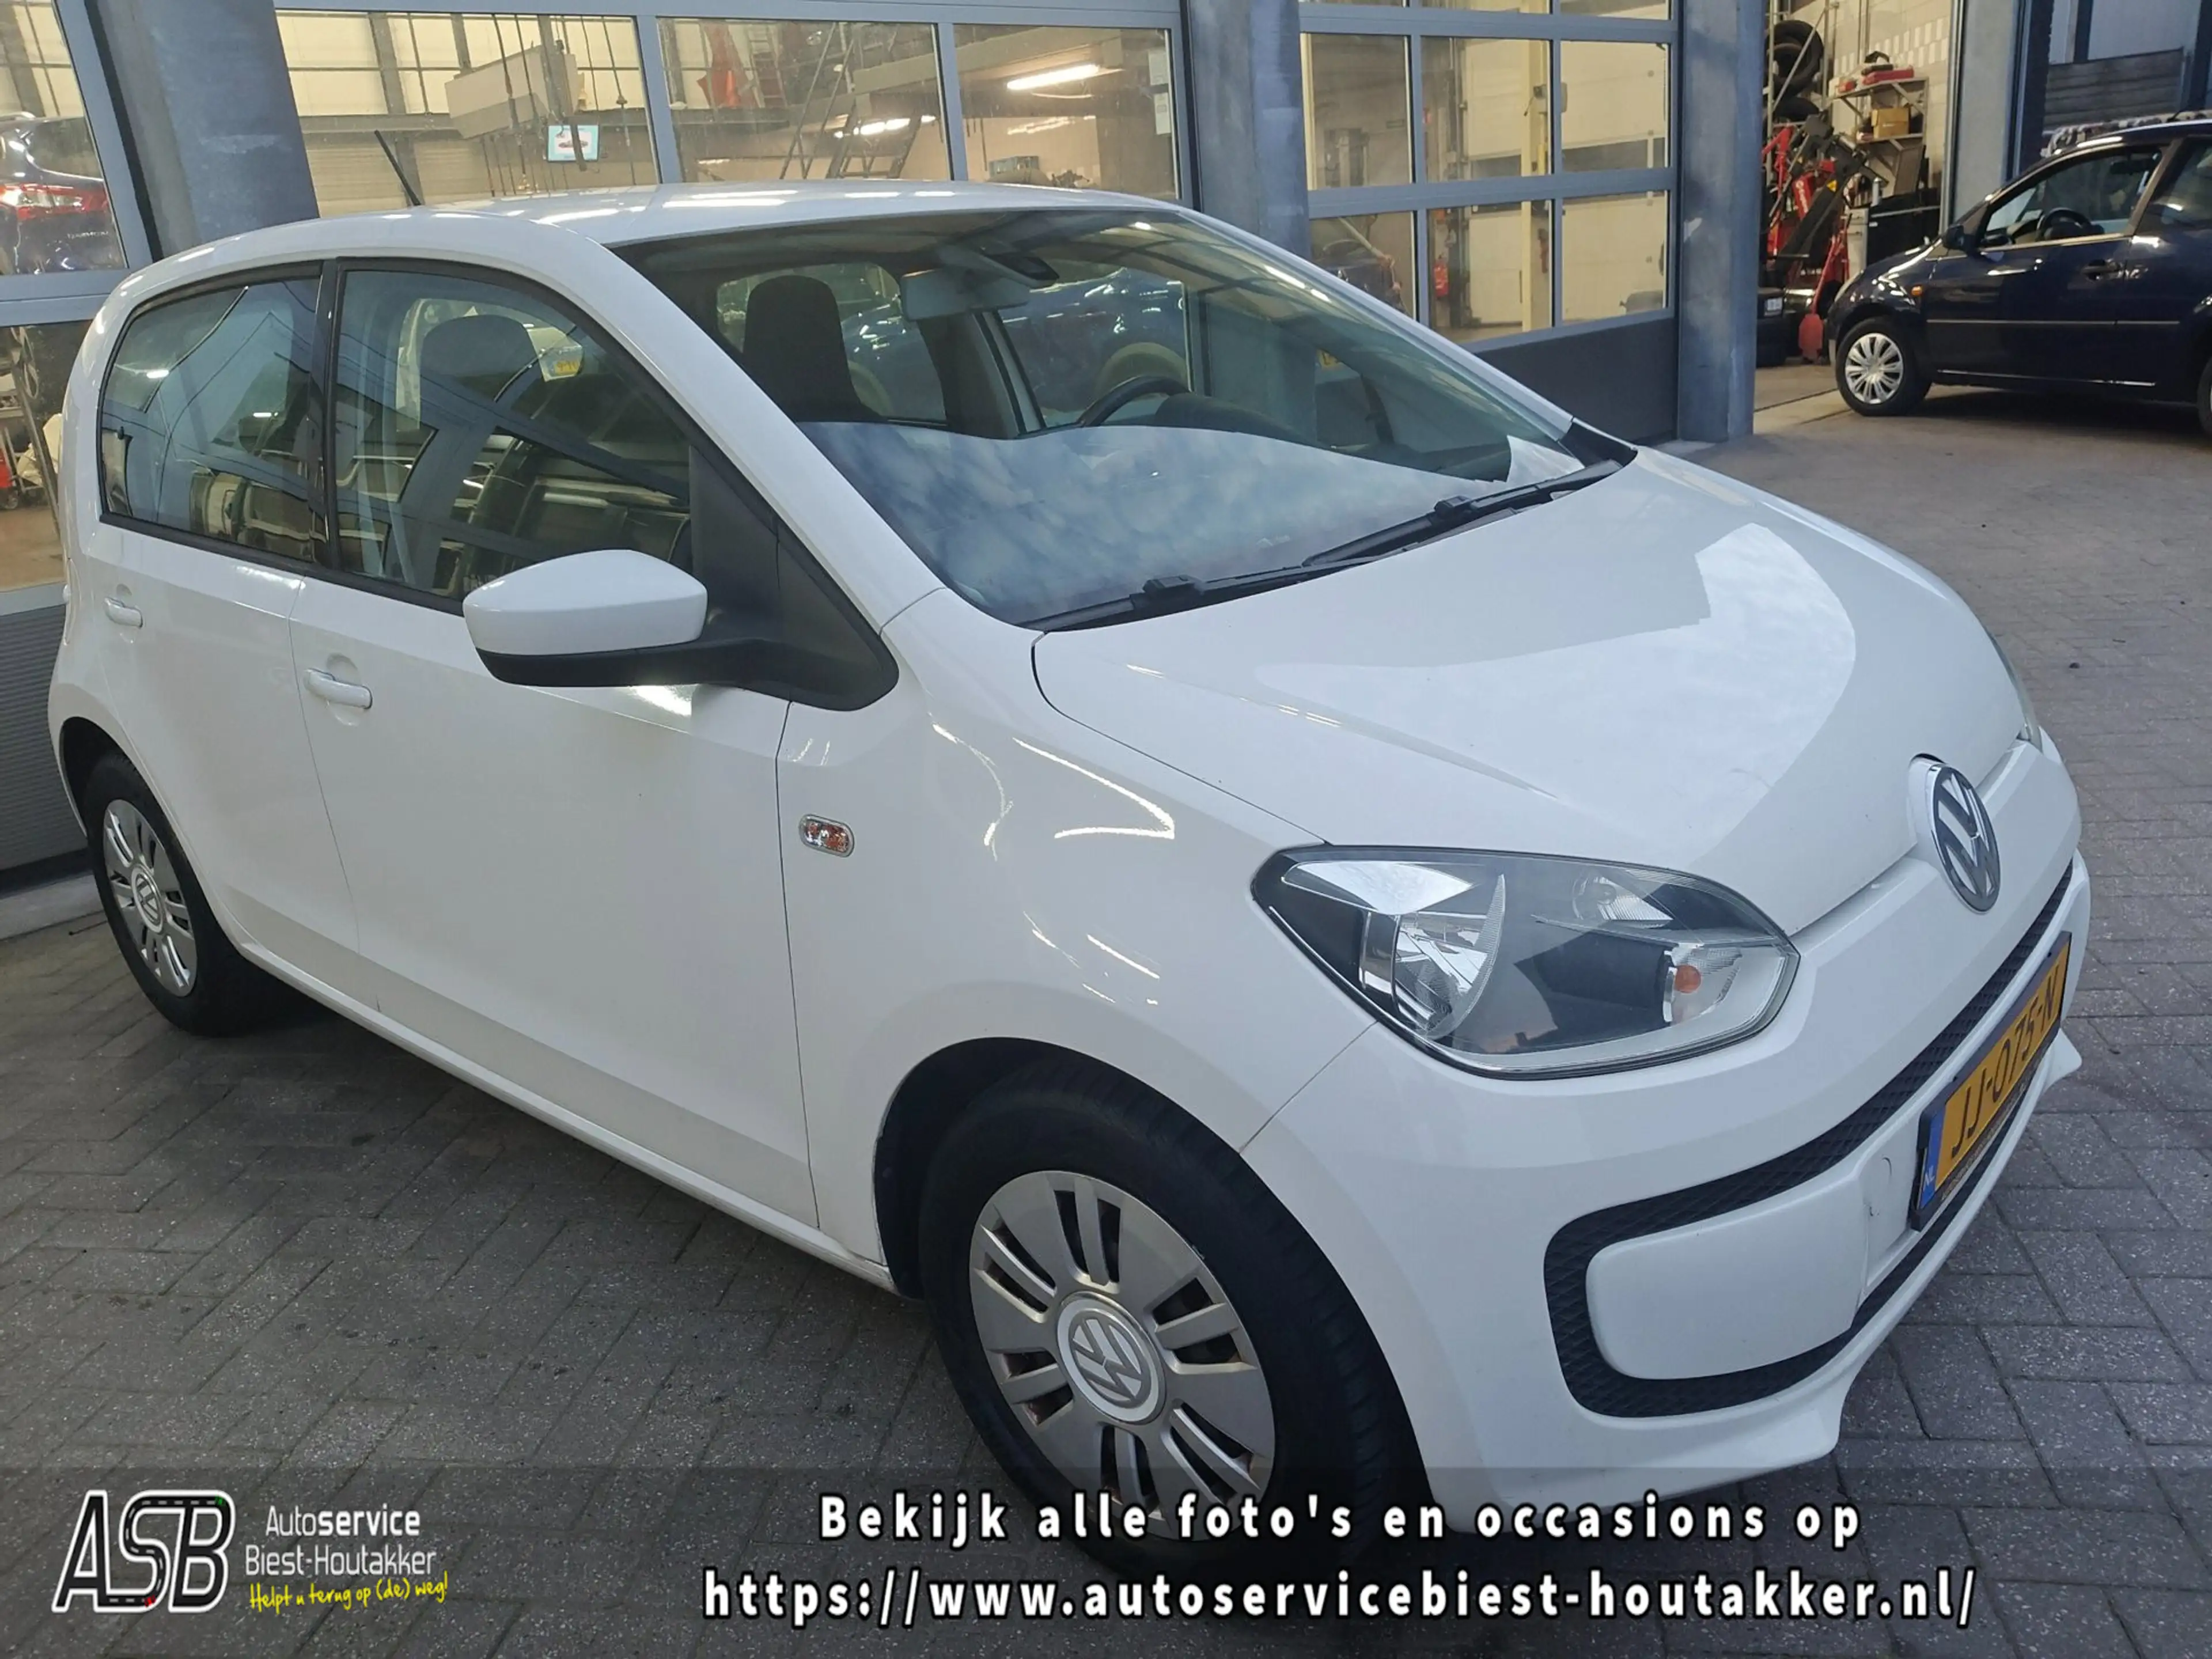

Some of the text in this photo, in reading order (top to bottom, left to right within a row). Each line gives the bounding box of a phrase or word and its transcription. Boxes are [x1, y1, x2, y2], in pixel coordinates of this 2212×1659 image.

[1934, 767, 2000, 910] VW
[1951, 963, 2060, 1159] JJ-075-N
[1922, 1165, 1936, 1192] NL
[1067, 1306, 1152, 1411] VW
